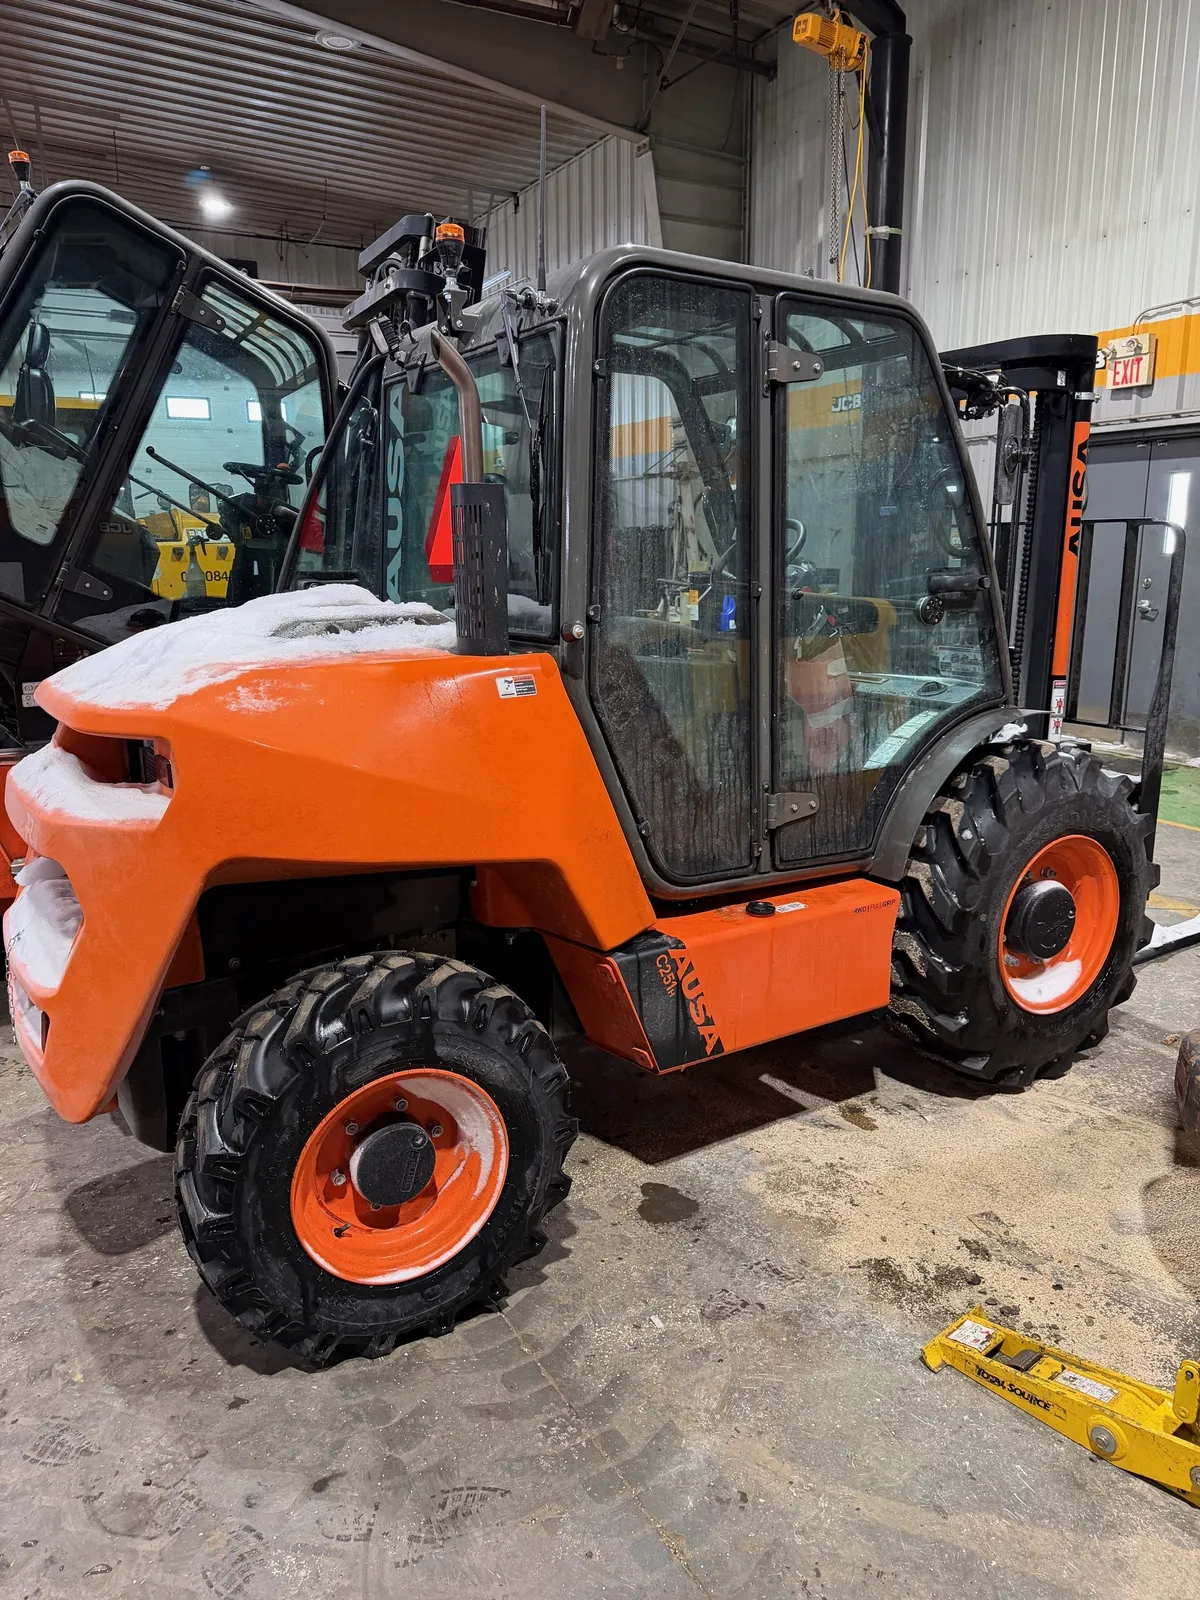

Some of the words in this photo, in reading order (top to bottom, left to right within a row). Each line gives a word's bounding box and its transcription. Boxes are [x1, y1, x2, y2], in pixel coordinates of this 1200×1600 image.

[1112, 356, 1143, 387] EXIT
[832, 393, 862, 414] JCB
[386, 383, 405, 605] AUSA
[656, 954, 676, 998] C251H
[668, 949, 720, 1056] AUSA
[1007, 1383, 1052, 1411] SOURCE
